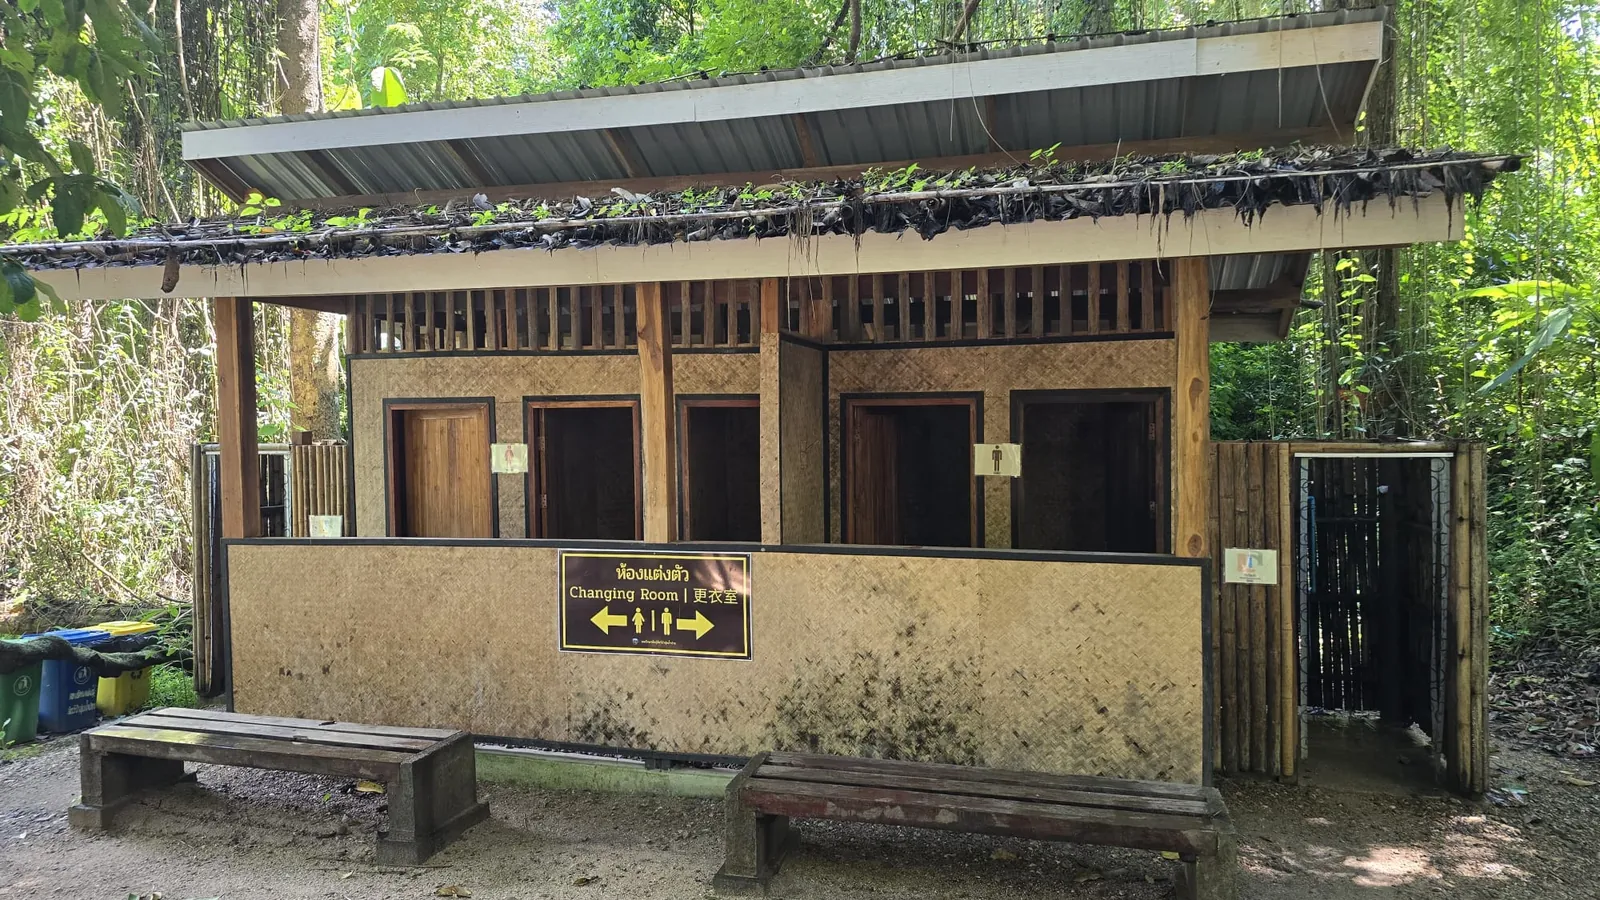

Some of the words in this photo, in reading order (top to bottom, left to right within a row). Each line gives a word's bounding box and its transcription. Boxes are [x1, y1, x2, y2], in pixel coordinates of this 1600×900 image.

[615, 562, 690, 582] ห้องแต่งตัว
[569, 586, 635, 602] Changing
[640, 588, 679, 602] Room
[693, 588, 739, 605] 更衣室
